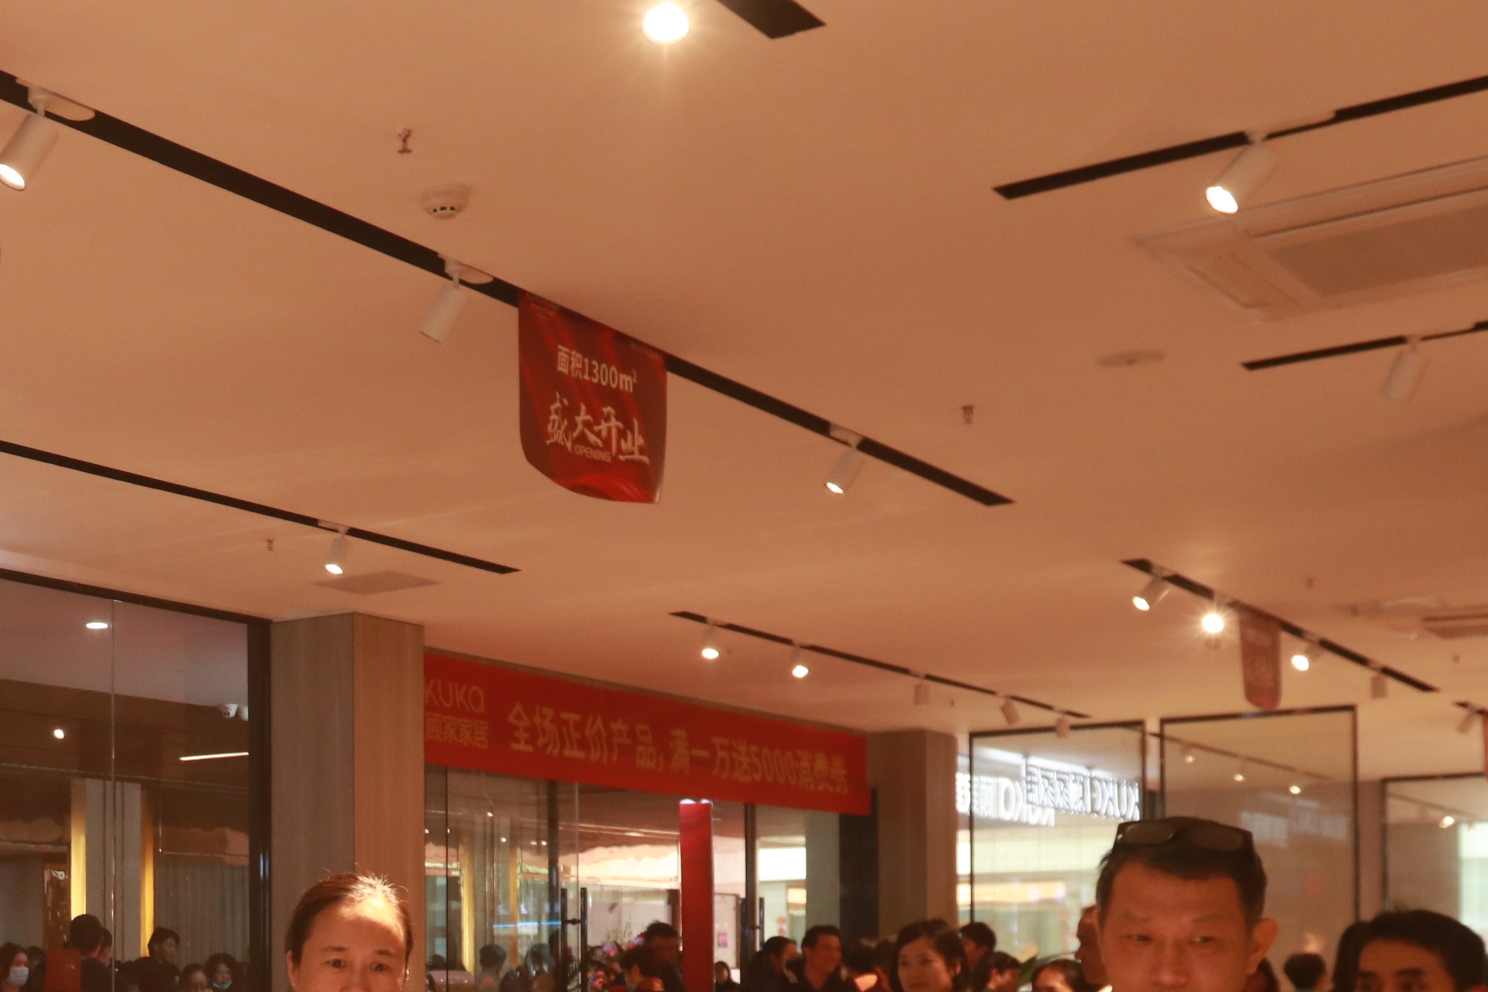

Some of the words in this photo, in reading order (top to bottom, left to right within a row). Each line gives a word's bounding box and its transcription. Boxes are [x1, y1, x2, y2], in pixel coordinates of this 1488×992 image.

[545, 391, 650, 465] 盛大开业
[574, 444, 612, 463] OPENING
